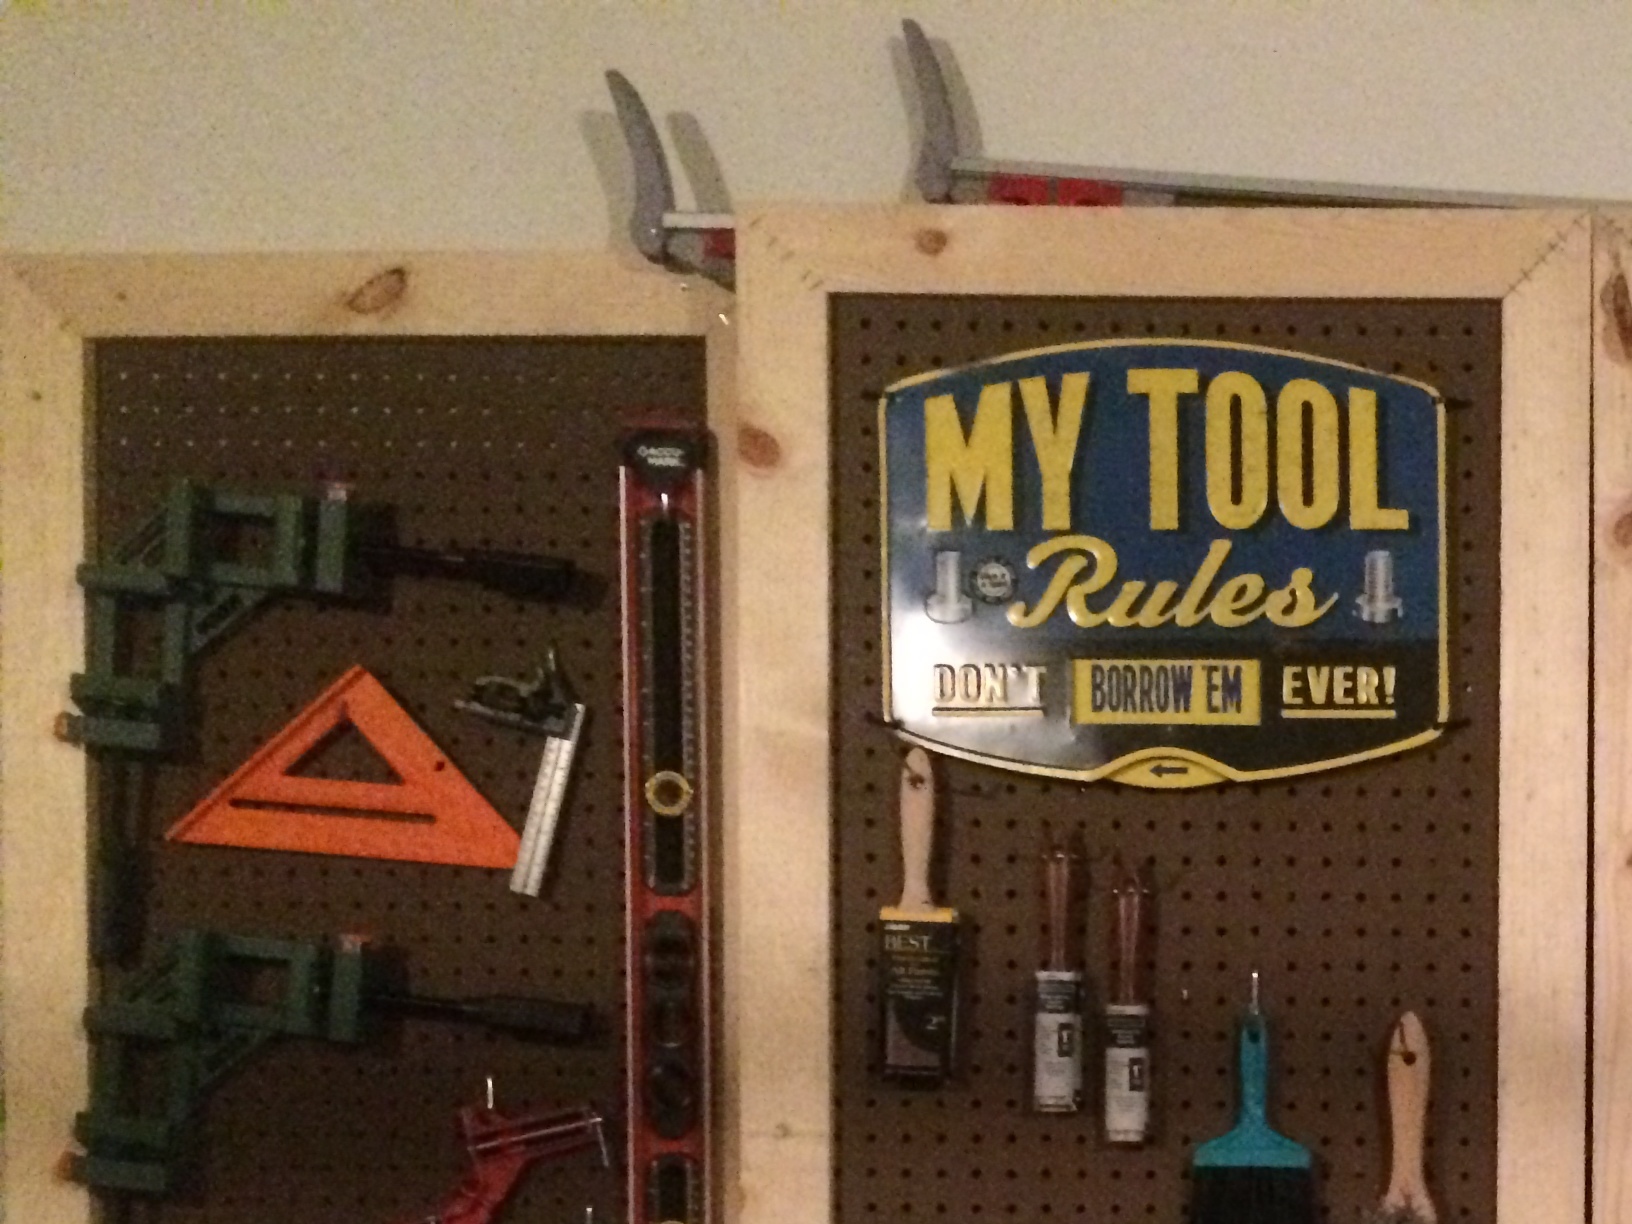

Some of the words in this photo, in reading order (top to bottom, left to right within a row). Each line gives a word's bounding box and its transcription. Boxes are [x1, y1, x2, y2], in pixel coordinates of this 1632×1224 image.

[924, 371, 1091, 531] MY
[1126, 367, 1410, 531] TOOL
[1005, 534, 1339, 629] Rules
[933, 662, 1047, 704] DON'T
[1091, 664, 1193, 713] BORROW
[1282, 665, 1397, 705] EVER!
[884, 934, 932, 953] BEST
